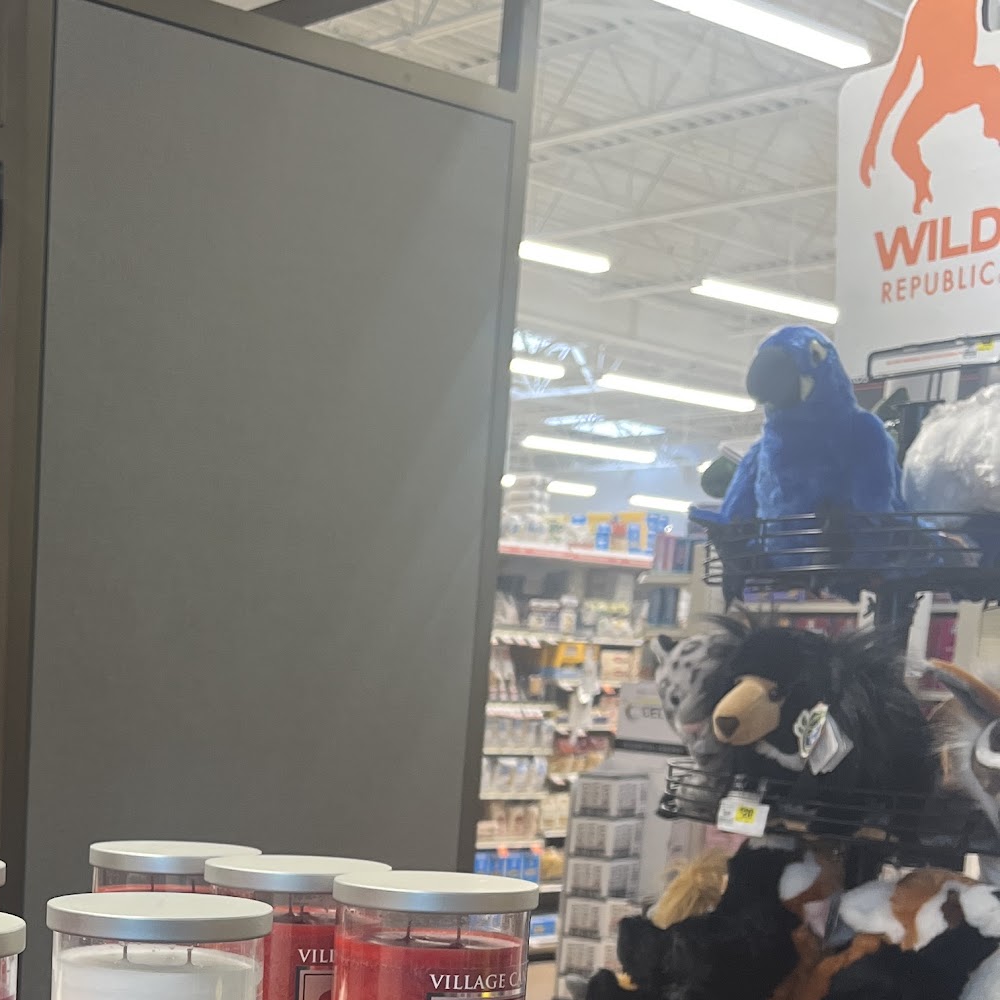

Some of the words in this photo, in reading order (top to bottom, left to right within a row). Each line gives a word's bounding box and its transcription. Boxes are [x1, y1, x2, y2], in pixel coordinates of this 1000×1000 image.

[873, 206, 1000, 272] WILD
[881, 261, 996, 304] REPUBLIC
[429, 974, 506, 990] VILLAGE
